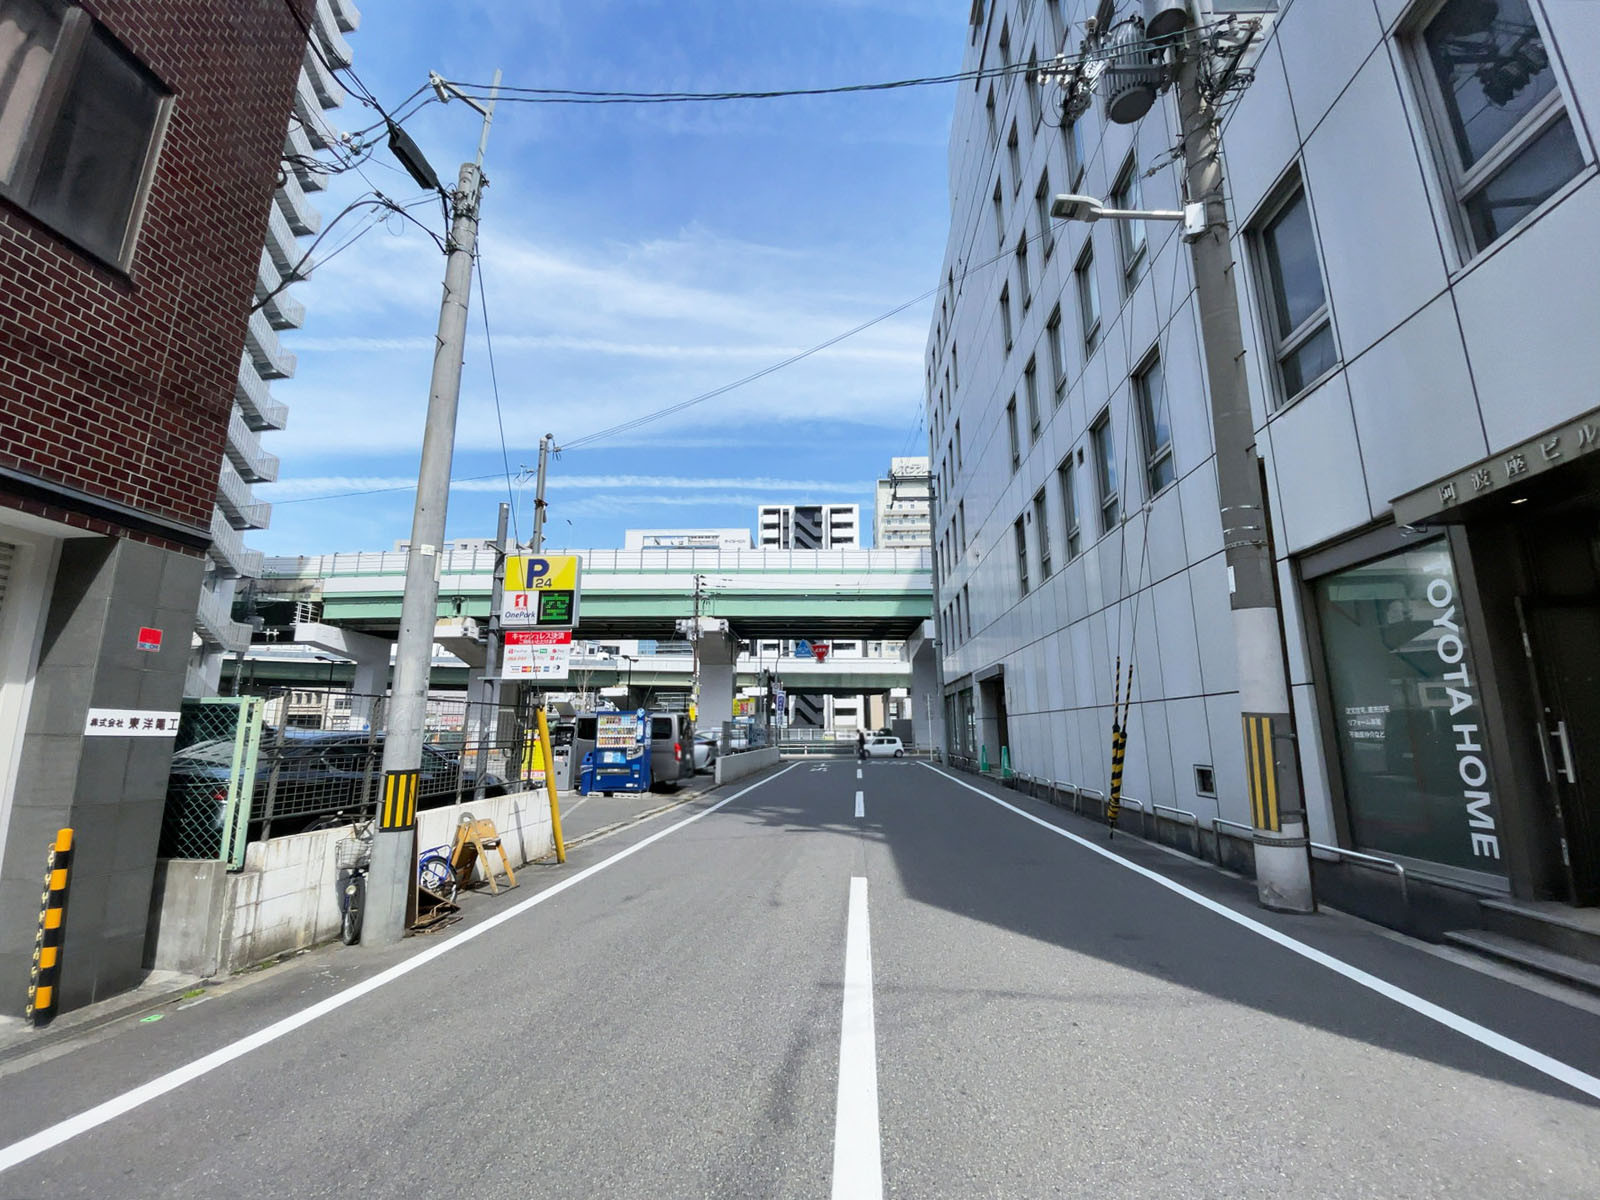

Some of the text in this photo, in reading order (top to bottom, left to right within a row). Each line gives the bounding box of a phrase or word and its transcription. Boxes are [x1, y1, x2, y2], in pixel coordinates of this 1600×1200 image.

[1439, 424, 1599, 503] 阿波座ビル
[526, 558, 552, 588] P 24
[505, 611, 536, 619] OnePark
[512, 632, 565, 641] キャッシュレス決済
[1423, 553, 1500, 859] TOYOTA HOME
[90, 717, 178, 730] 株式会社 東洋電工
